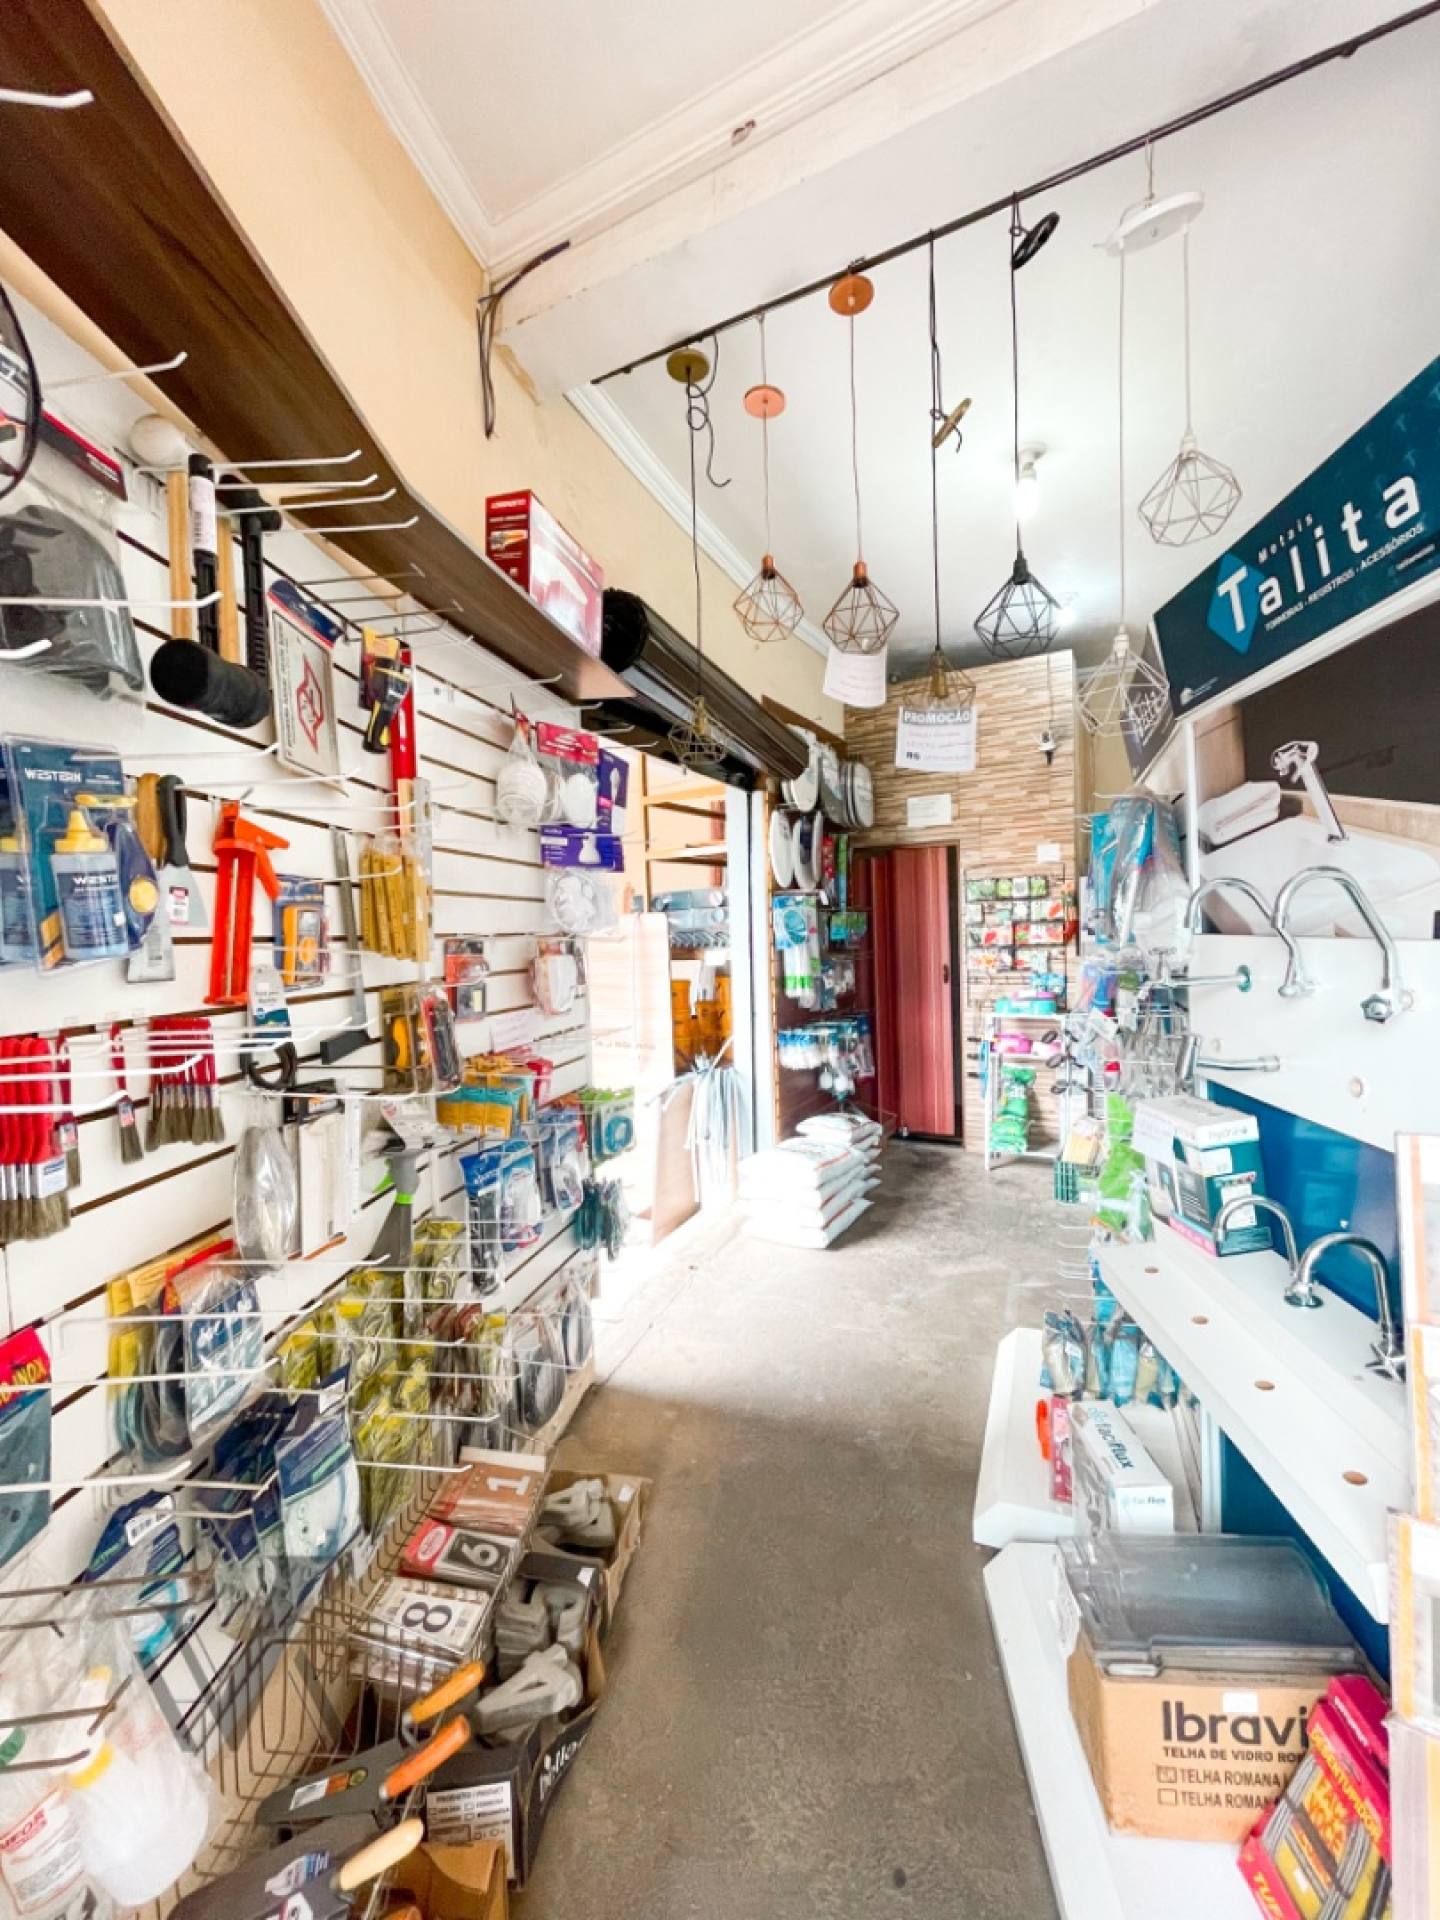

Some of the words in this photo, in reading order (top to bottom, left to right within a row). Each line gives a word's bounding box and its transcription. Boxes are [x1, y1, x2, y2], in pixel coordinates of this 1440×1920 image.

[1217, 475, 1421, 633] Talita
[24, 767, 82, 783] WESTERN
[402, 1601, 453, 1633] 8
[1162, 1700, 1309, 1749] Ibravi
[1163, 1747, 1206, 1759] TELHA
[1210, 1749, 1227, 1761] DE
[1232, 1750, 1273, 1763] VIDRO
[1179, 1766, 1221, 1785] TELHA
[1224, 1769, 1281, 1788] ROMANA
[1181, 1790, 1220, 1808] TELHA
